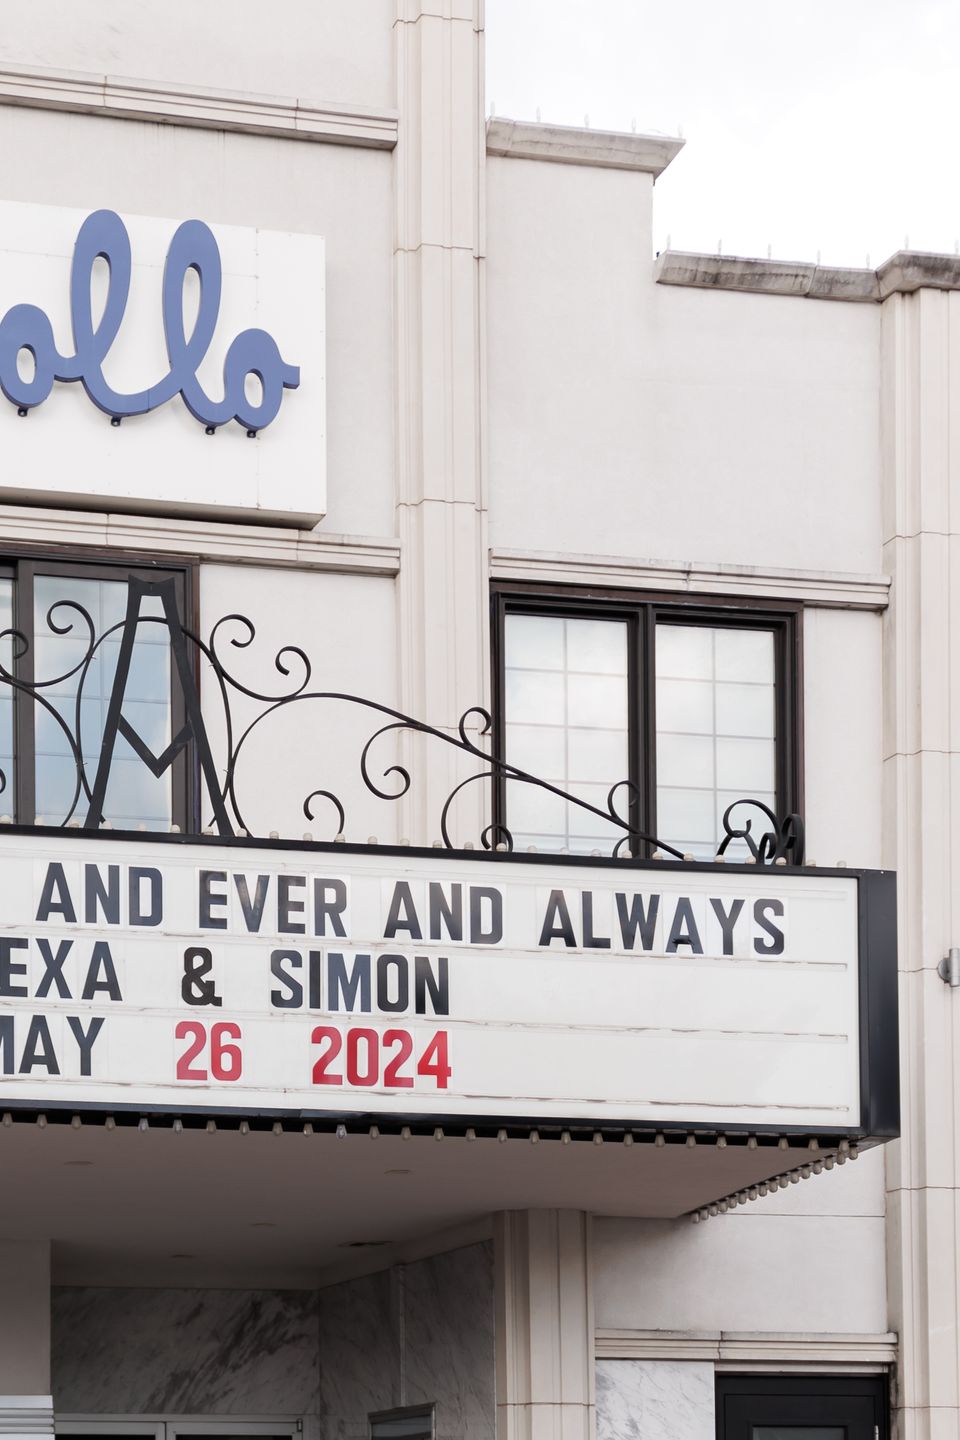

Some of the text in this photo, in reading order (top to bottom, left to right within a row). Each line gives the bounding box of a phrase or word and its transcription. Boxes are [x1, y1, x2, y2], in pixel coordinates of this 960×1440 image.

[36, 863, 162, 926] AND
[200, 871, 346, 937] EVER
[384, 882, 502, 944] AND
[539, 890, 784, 955] ALWAYS
[182, 947, 222, 1006] &
[271, 950, 449, 1015] SIMON
[176, 1022, 241, 1081] 26
[312, 1026, 451, 1088] 2024
